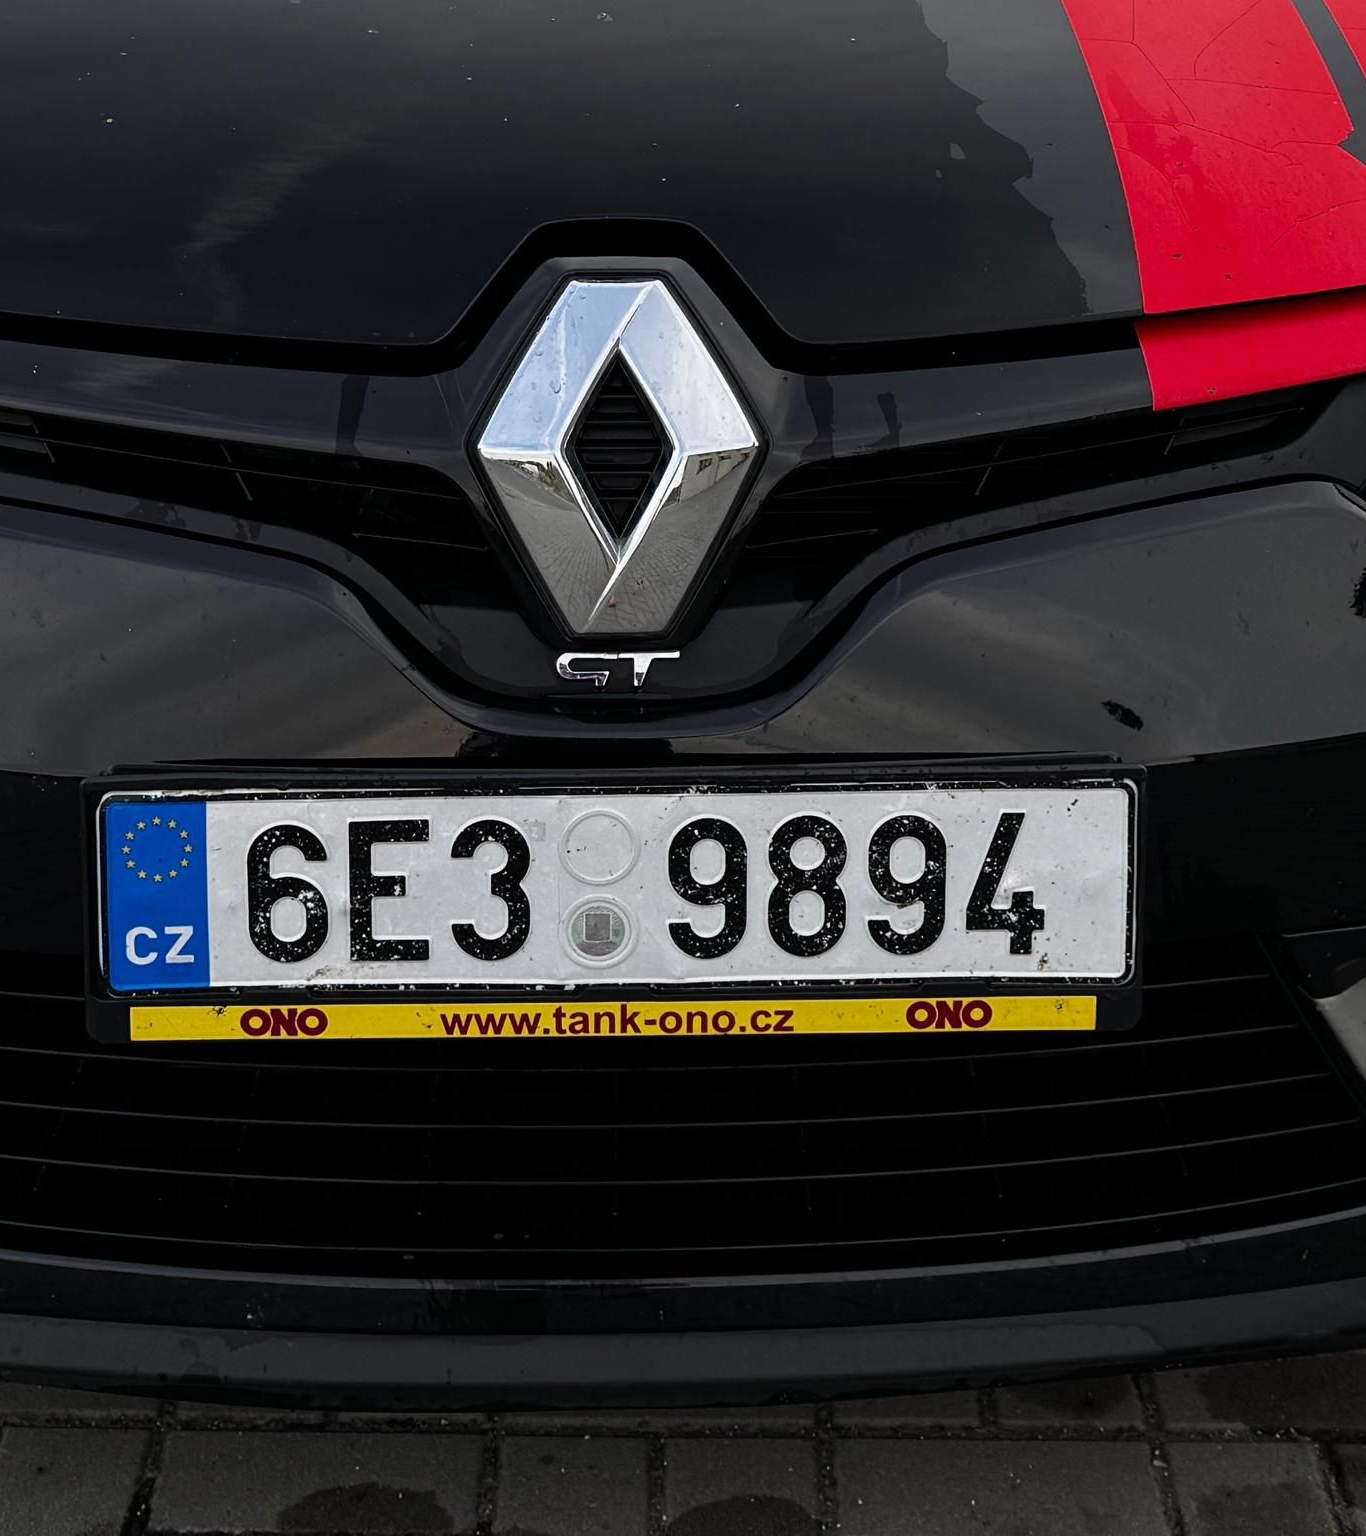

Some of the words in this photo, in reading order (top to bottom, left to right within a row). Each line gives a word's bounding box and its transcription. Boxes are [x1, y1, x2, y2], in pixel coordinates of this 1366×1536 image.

[555, 650, 681, 687] GT
[246, 819, 531, 963] 6E3
[667, 811, 1046, 960] 9894
[125, 925, 195, 965] CZ
[239, 1007, 329, 1037] ONO
[439, 1004, 795, 1035] www.tank-ono.cz
[905, 999, 994, 1031] ONO
